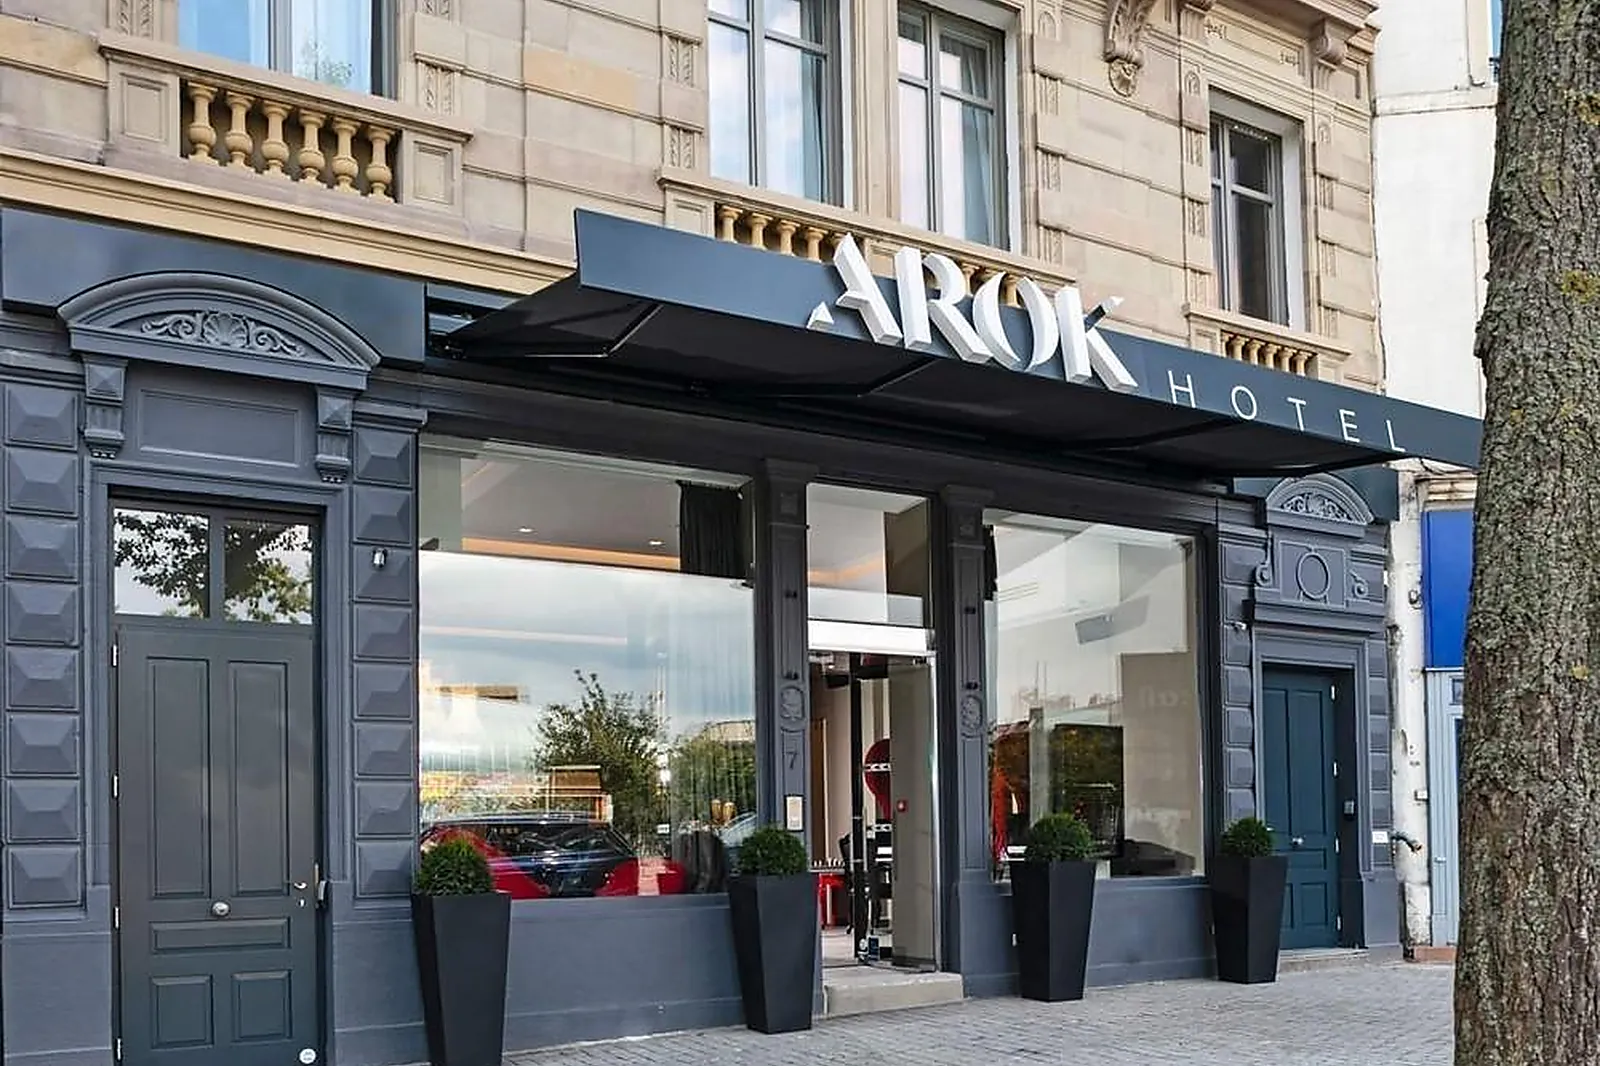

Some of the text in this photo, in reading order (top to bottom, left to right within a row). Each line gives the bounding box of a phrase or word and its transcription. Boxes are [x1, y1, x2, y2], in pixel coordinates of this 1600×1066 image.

[806, 232, 1406, 453] AROK HOTEL
[785, 750, 798, 770] 7
